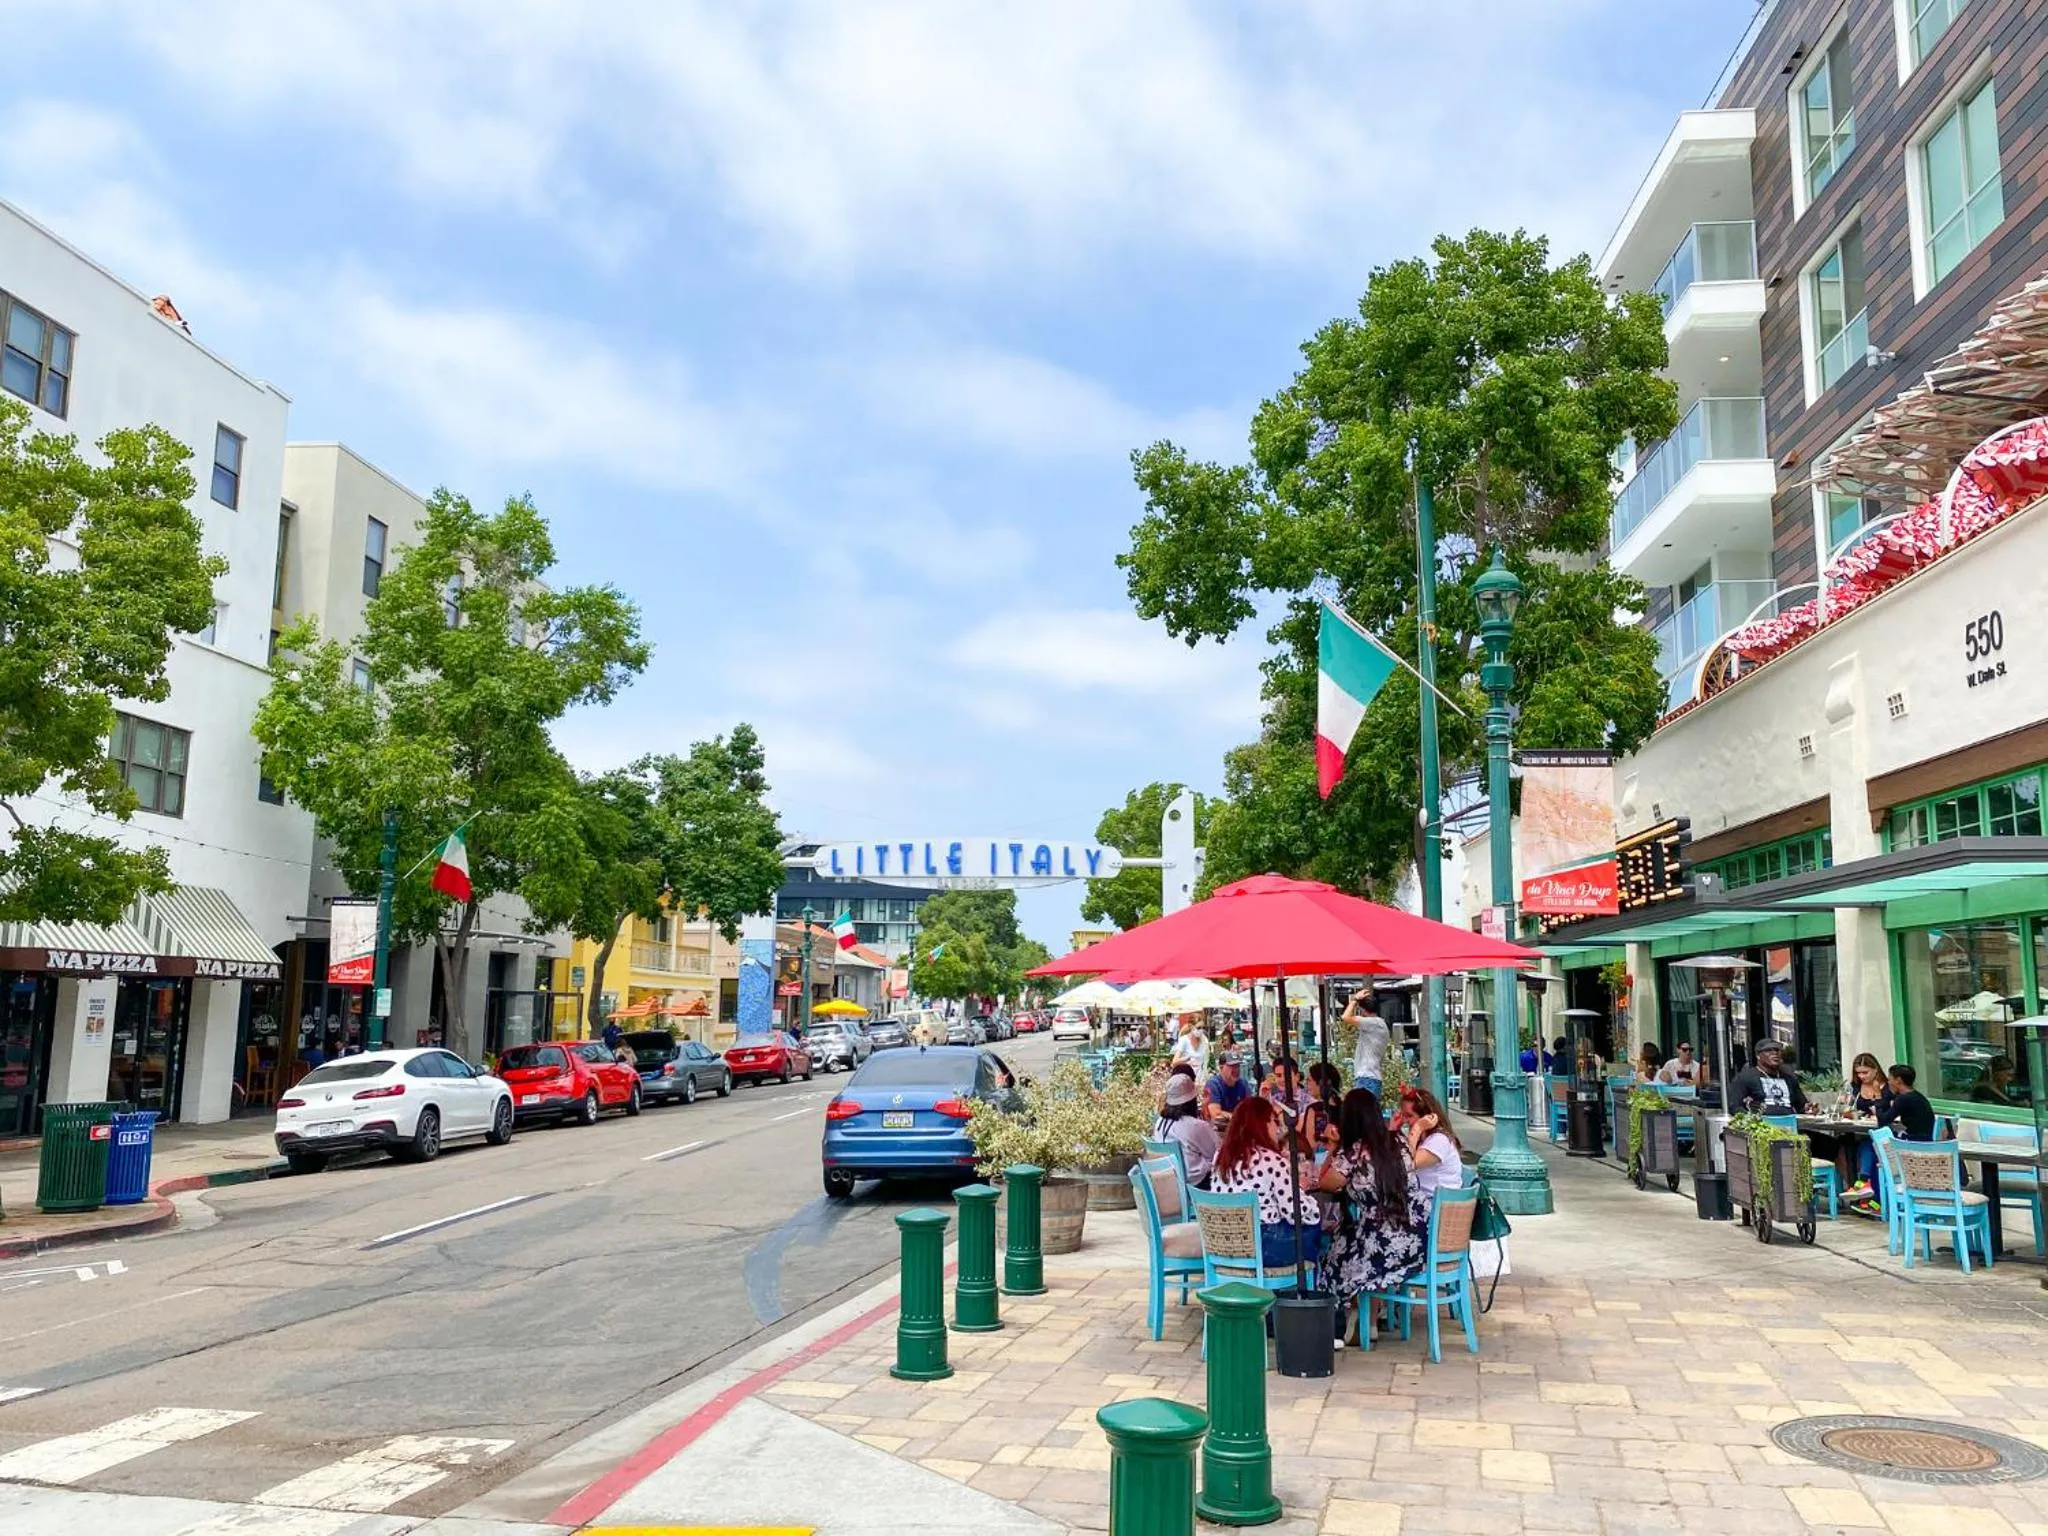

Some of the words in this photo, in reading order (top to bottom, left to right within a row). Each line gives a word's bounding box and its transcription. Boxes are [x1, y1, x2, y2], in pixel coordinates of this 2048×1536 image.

[1965, 609, 2004, 662] 550
[831, 842, 963, 875] LITTLE
[991, 842, 1102, 876] ITALY
[1527, 883, 1541, 895] da
[1541, 880, 1576, 896] Vinci
[1578, 882, 1612, 901] Days
[46, 950, 158, 973] NAPIZZA
[195, 959, 280, 979] NAPIZZA
